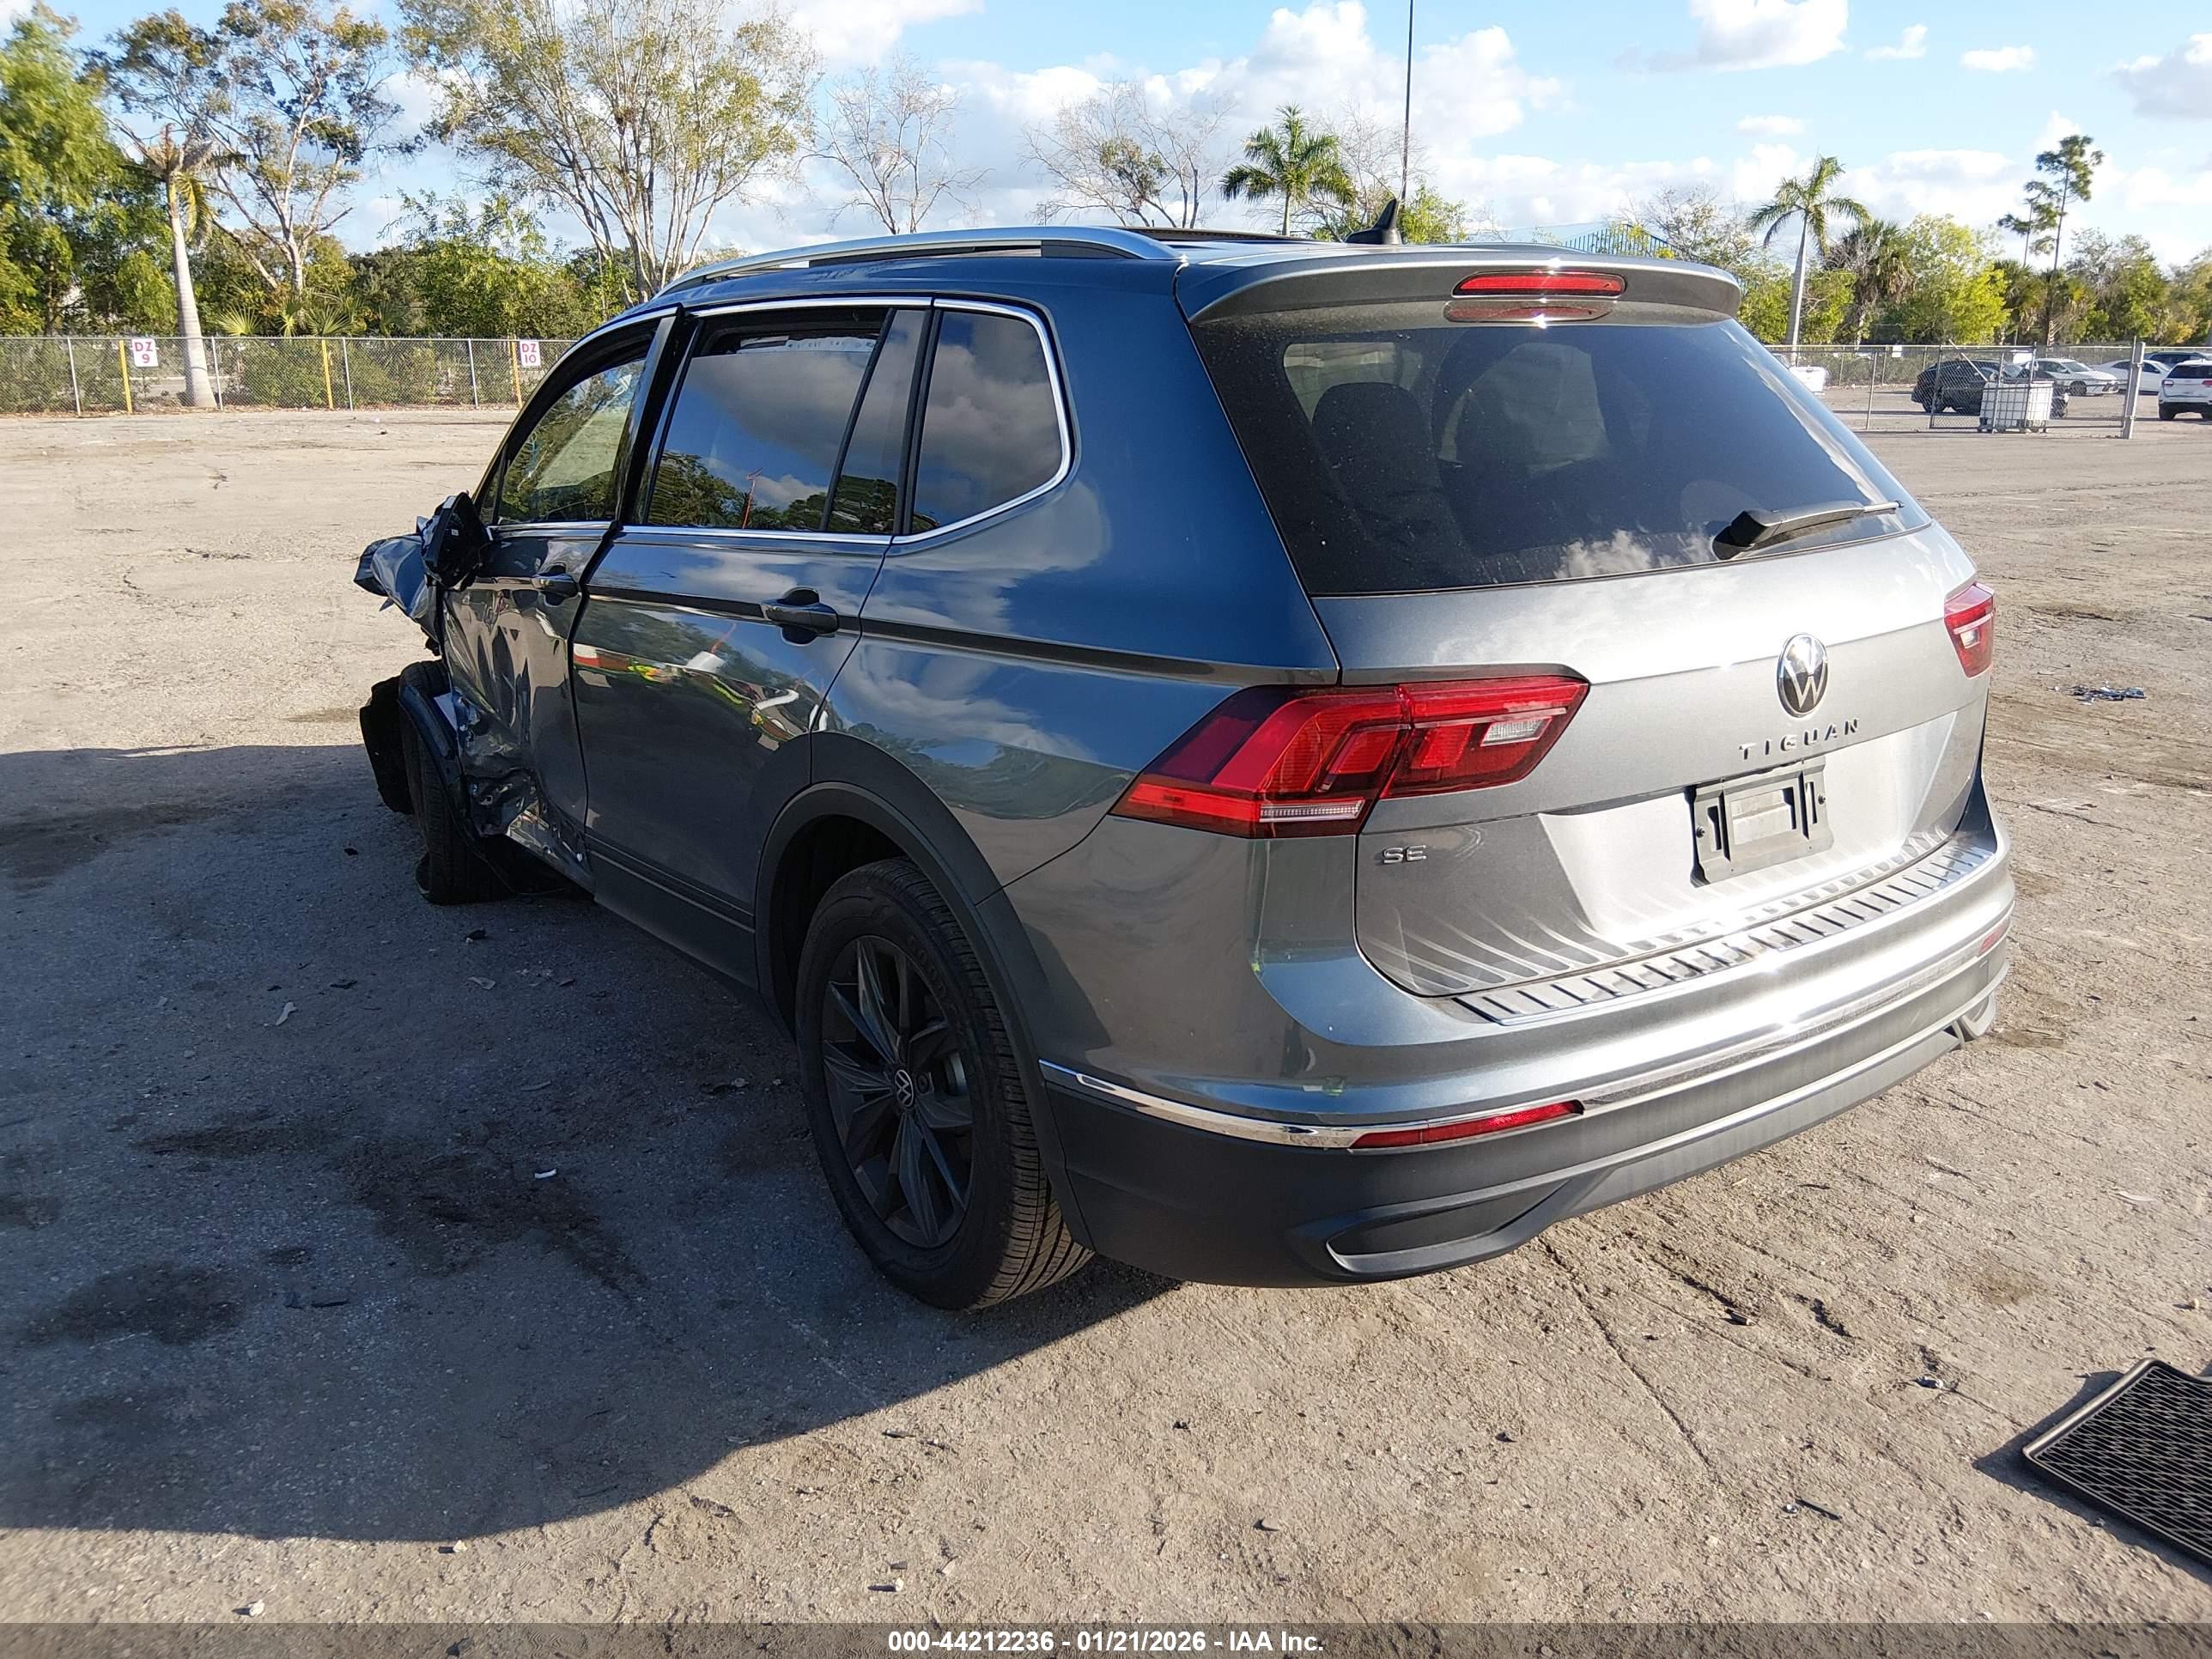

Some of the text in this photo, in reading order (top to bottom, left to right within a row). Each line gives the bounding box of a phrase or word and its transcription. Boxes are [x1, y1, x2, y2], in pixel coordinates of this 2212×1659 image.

[134, 341, 154, 352] DZ
[521, 343, 538, 353] DZ
[142, 353, 150, 364] 9
[524, 354, 537, 364] 10
[1738, 718, 1860, 761] TIGUAN
[1382, 845, 1427, 864] SE
